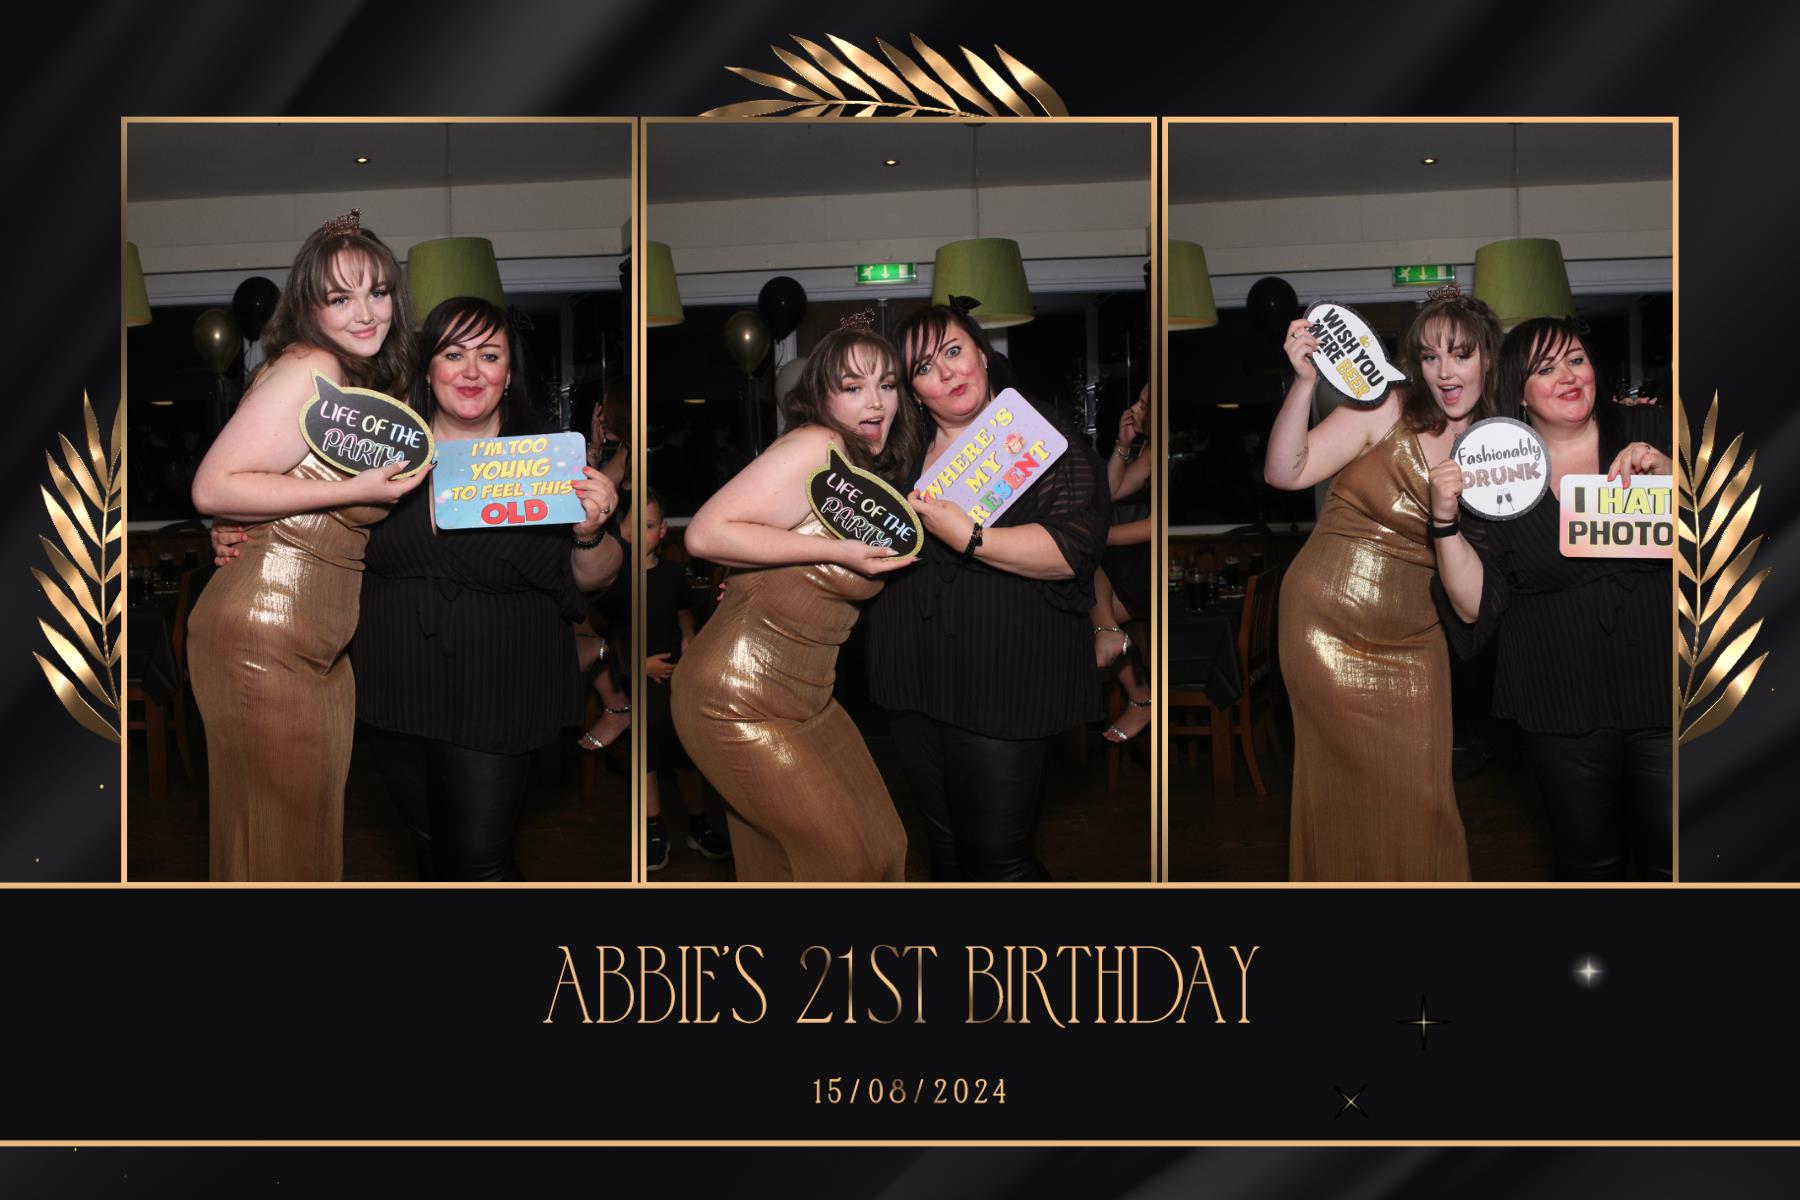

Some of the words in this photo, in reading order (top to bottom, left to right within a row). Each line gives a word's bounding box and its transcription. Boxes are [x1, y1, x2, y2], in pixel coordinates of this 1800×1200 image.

[1323, 307, 1360, 355] WISH
[1353, 348, 1384, 387] YOU
[1336, 358, 1370, 400] BEER
[320, 400, 361, 427] LIFE
[361, 415, 390, 436] OF
[389, 423, 424, 448] THE
[322, 427, 405, 468] PARTY
[471, 441, 503, 457] I'M
[509, 438, 548, 455] TOO
[919, 407, 1014, 500] WHERE'S
[1457, 437, 1542, 466] Fashionably
[451, 485, 478, 501] TO
[480, 481, 524, 499] FEEL
[530, 479, 573, 496] THIS
[470, 457, 551, 482] YOUNG
[965, 451, 1002, 494] MY
[967, 439, 1051, 525] RESENT
[1462, 461, 1542, 490] DRUNK
[481, 498, 549, 525] OLD
[826, 472, 863, 504] LIFE
[861, 498, 887, 518] OF
[883, 512, 916, 542] THE
[1574, 486, 1585, 513] I
[1598, 487, 1673, 515] HAT
[821, 496, 892, 548] PARTY
[1568, 520, 1673, 546] PHOTO
